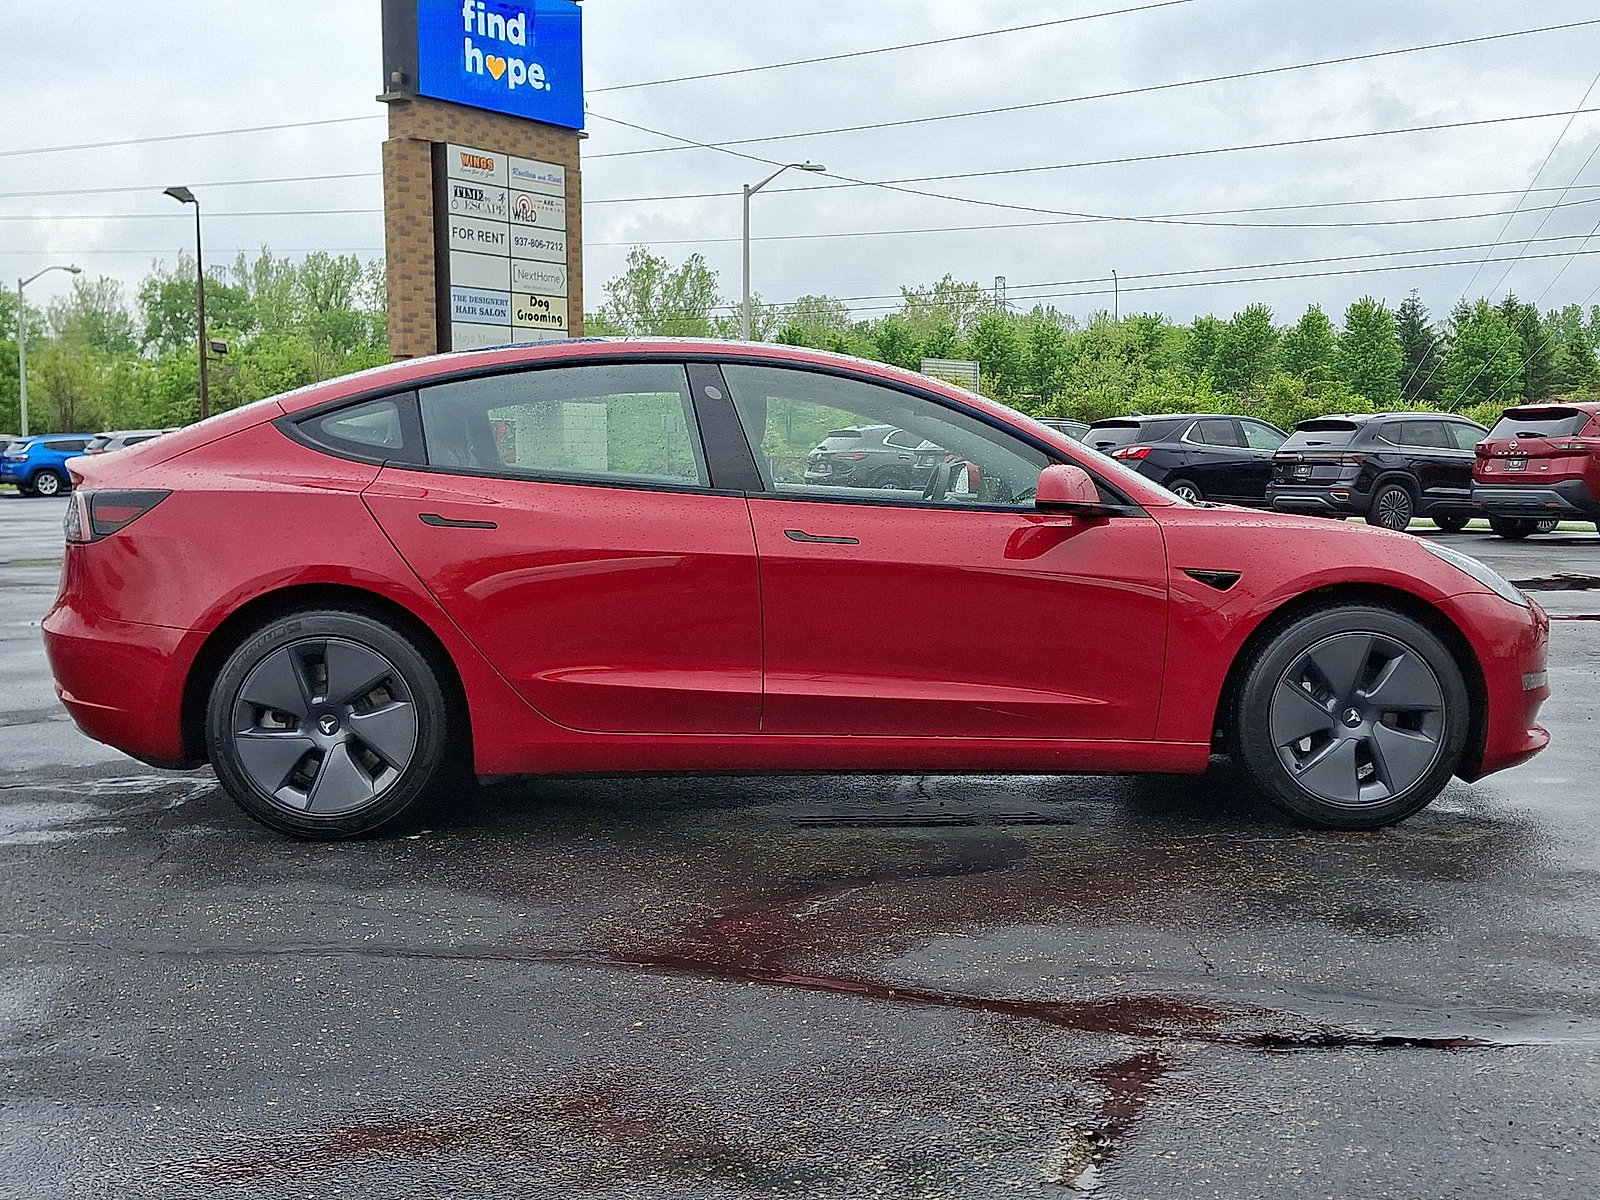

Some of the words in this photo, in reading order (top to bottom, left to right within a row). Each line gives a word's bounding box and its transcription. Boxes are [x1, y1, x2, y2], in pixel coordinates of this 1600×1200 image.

[463, 0, 525, 46] find
[461, 152, 494, 171] WINGS
[454, 186, 483, 201] TIME
[464, 200, 506, 216] ESCAPE
[452, 227, 474, 240] FOR
[478, 230, 505, 244] RENT
[514, 236, 564, 252] 937-806-7212
[518, 268, 560, 284] NextHome
[453, 294, 467, 303] THE
[469, 296, 509, 307] DESIGNERY
[529, 296, 550, 311] Dog
[456, 305, 477, 315] HAIR
[479, 307, 507, 317] SALON
[517, 309, 563, 327] Grooming
